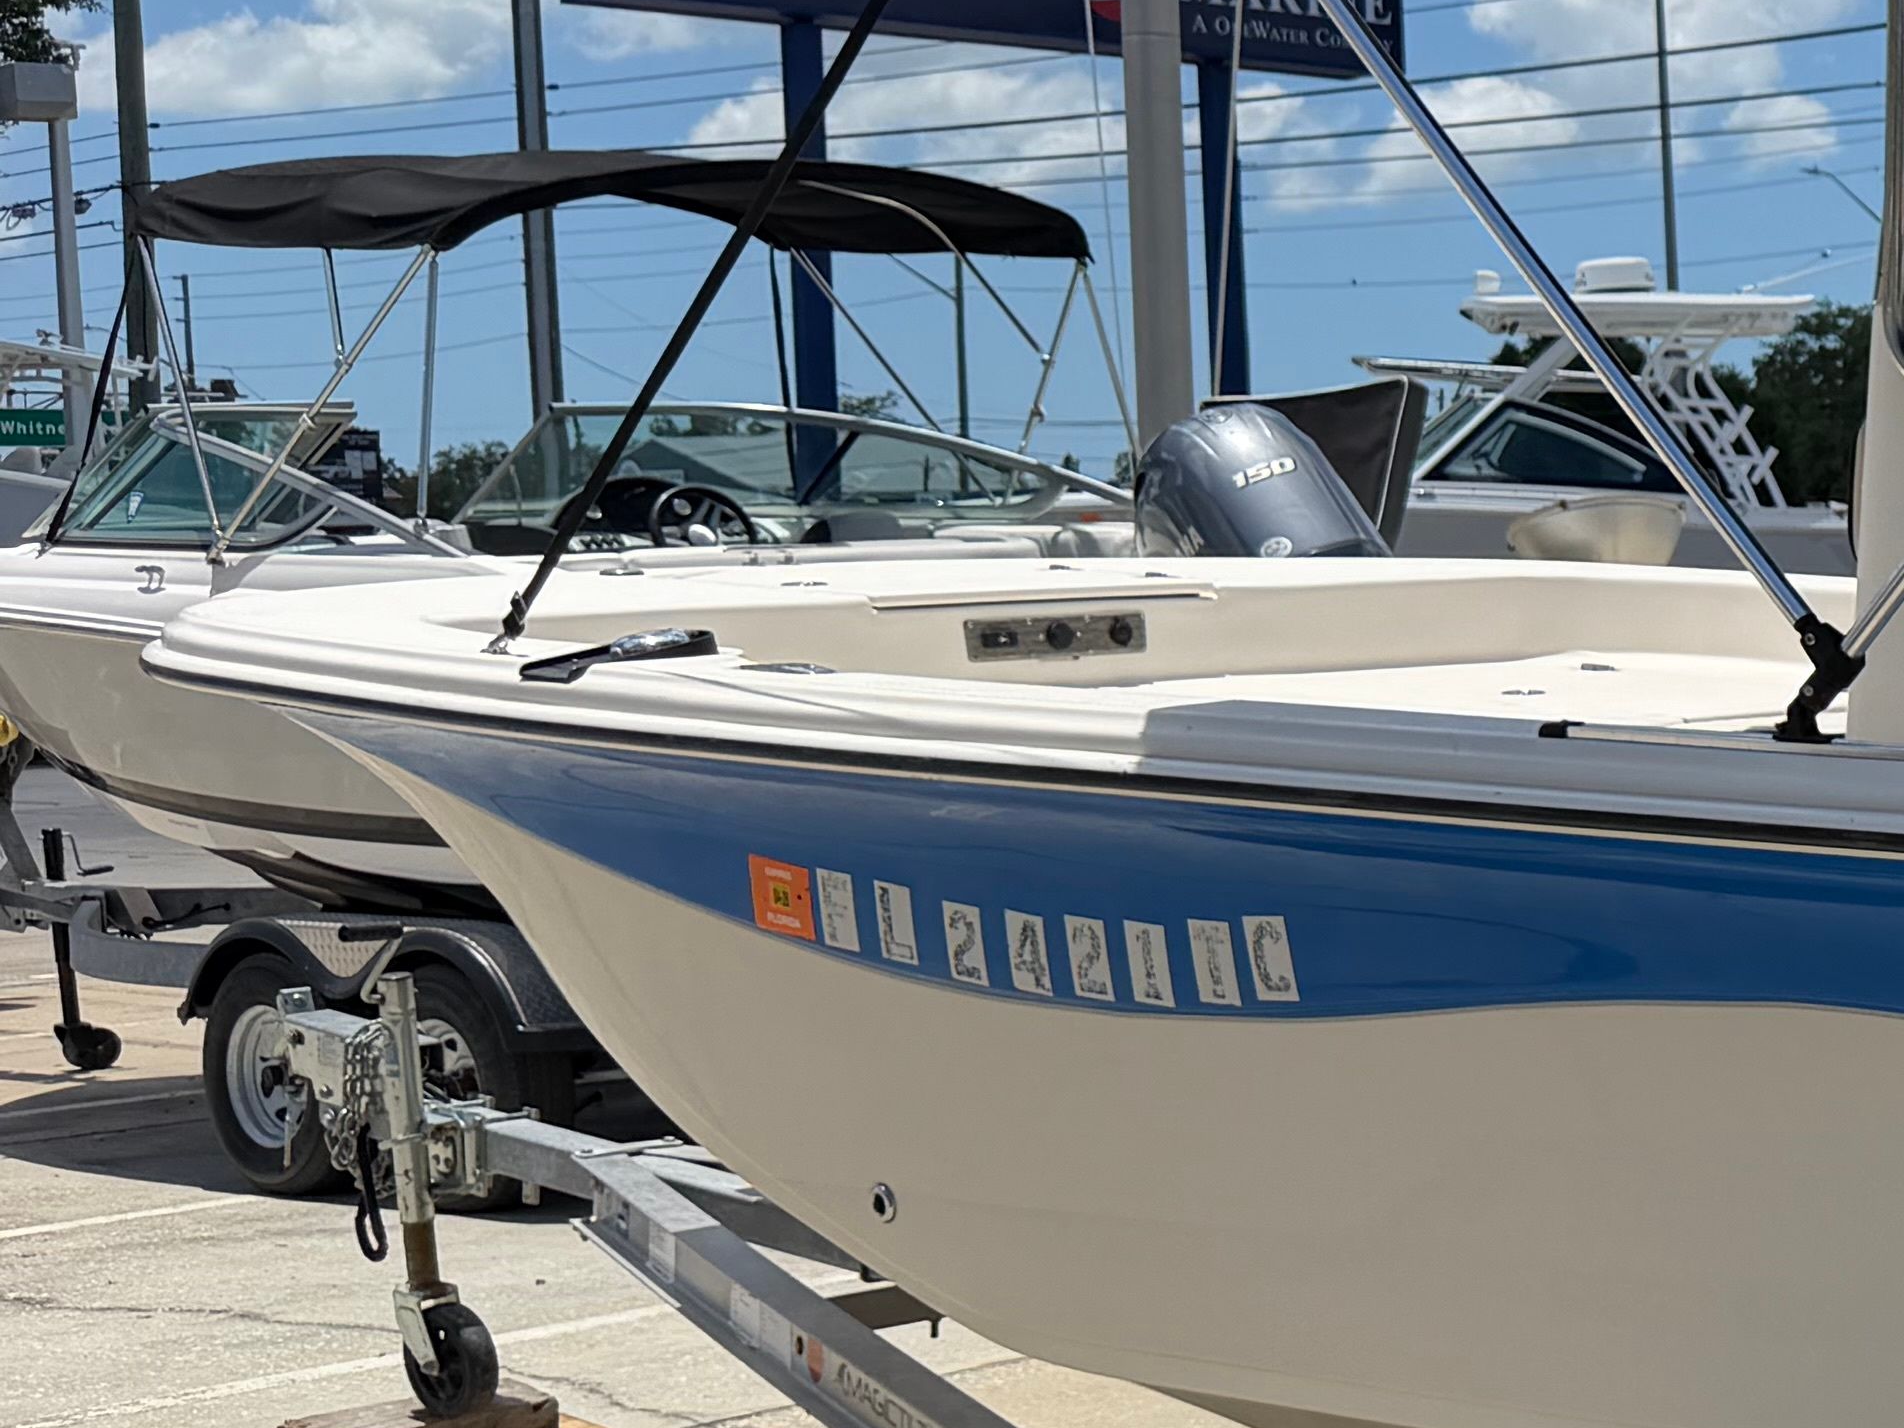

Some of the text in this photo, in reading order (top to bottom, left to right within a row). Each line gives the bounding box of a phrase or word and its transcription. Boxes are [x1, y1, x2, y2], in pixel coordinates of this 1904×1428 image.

[1215, 15, 1310, 46] OWATER
[0, 419, 65, 436] Whitne
[1231, 456, 1297, 489] 150
